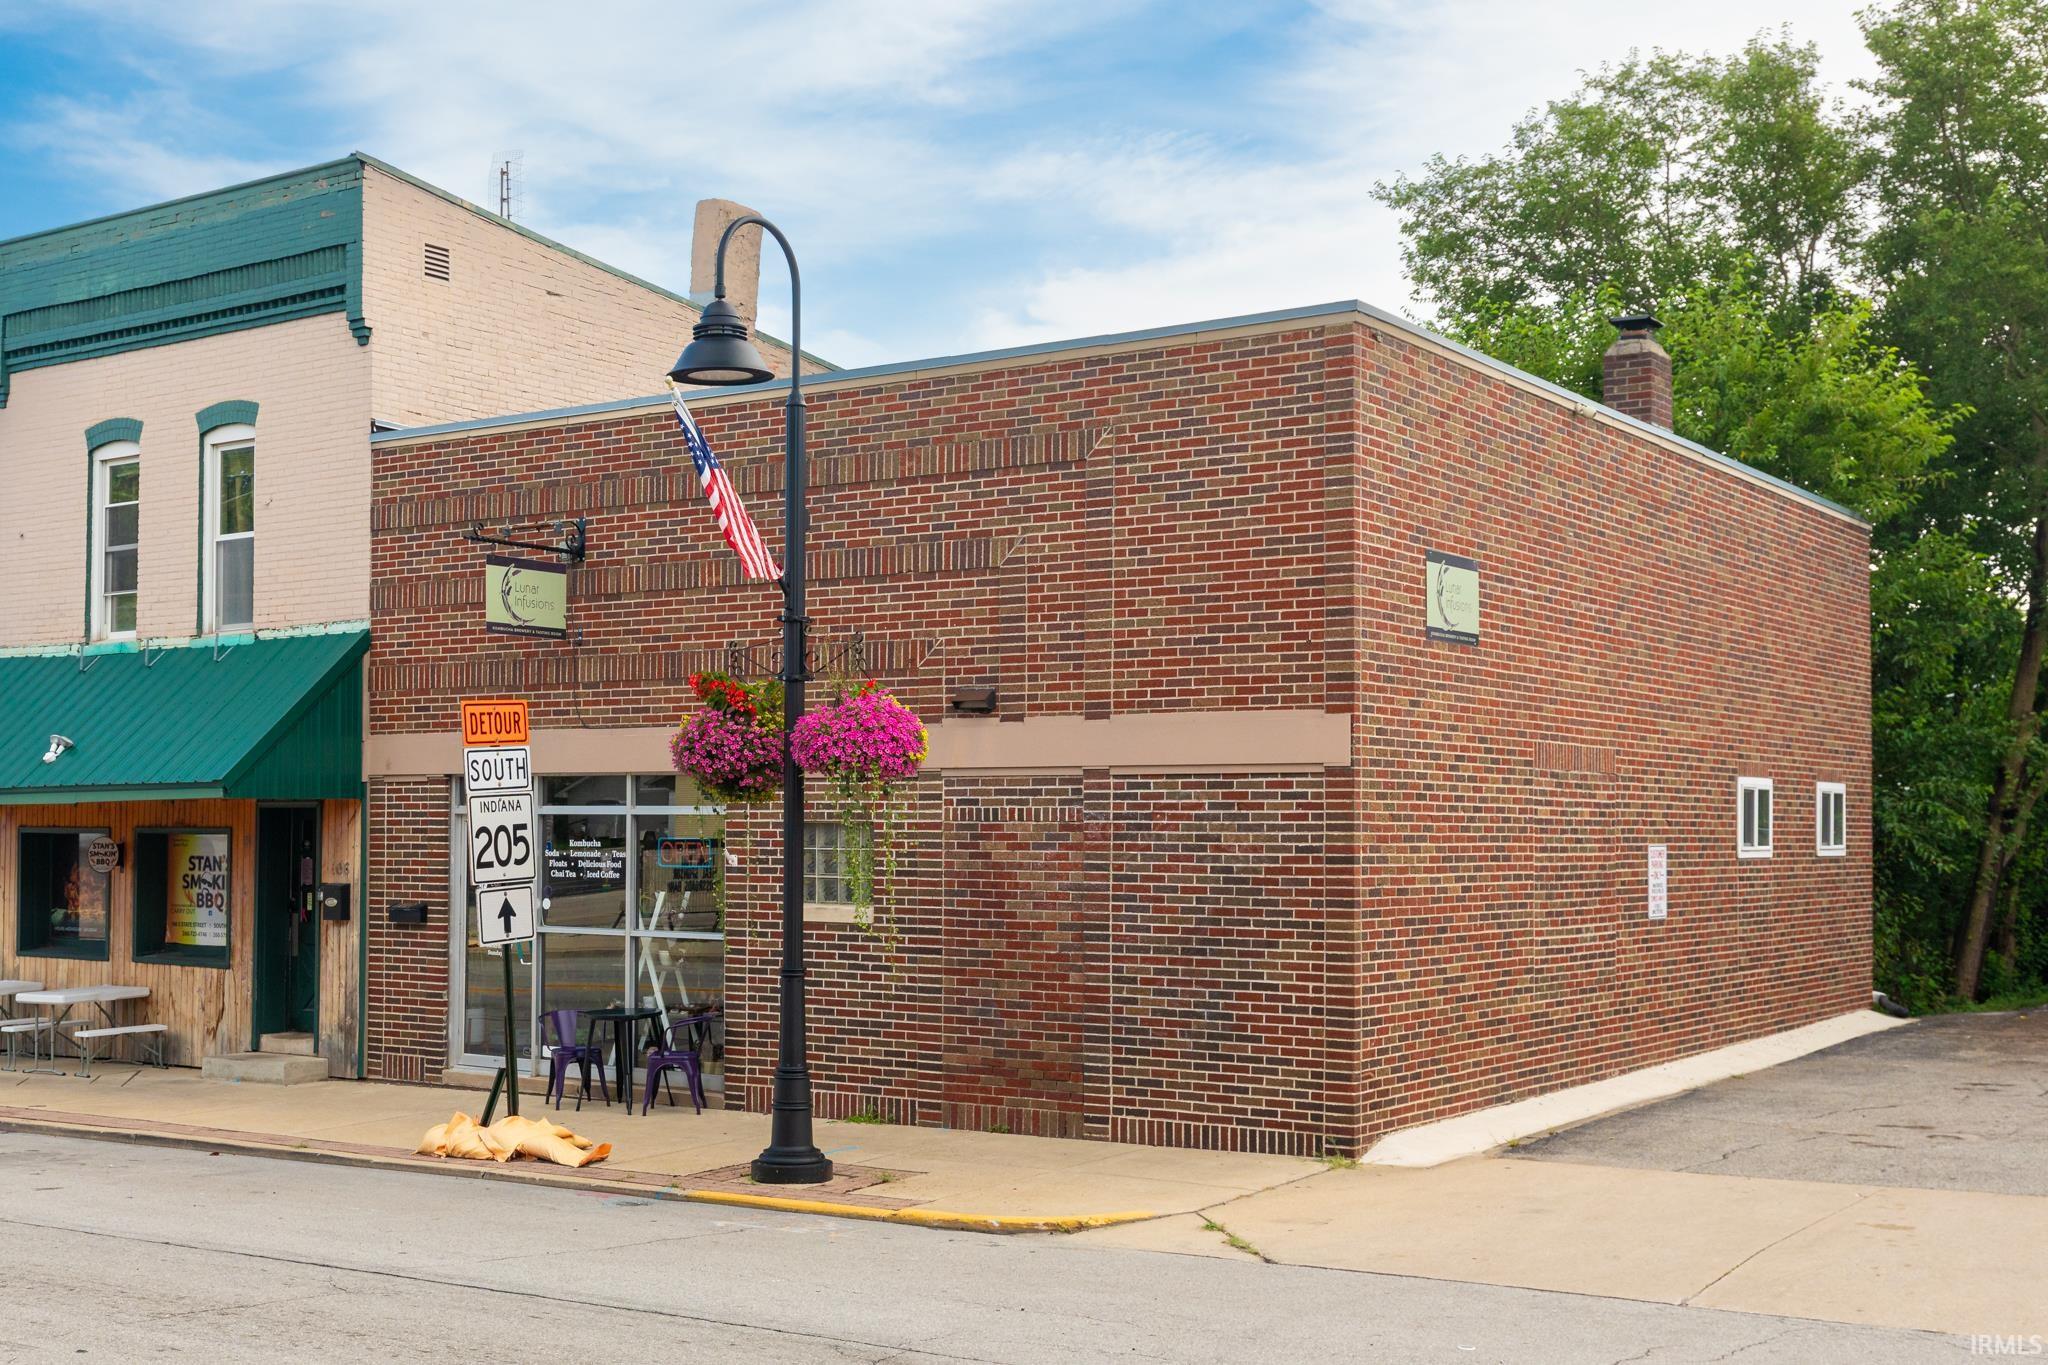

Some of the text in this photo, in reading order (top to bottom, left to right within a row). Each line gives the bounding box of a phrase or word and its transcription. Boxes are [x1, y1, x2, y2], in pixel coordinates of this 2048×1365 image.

[515, 582, 539, 594] Lunar
[515, 595, 555, 611] Infusions
[469, 711, 522, 735] DETOUR
[470, 757, 526, 782] SOUTH
[480, 799, 522, 813] INDIANA
[93, 842, 115, 850] STAN'S
[474, 823, 530, 869] 205
[569, 839, 602, 848] Kombucha
[544, 849, 559, 857] Soda
[570, 849, 601, 857] Lemonade
[661, 841, 709, 862] OPEN
[96, 858, 110, 866] BBQ
[188, 854, 229, 872] STAN'
[549, 859, 622, 868] Floats Delicious Food
[550, 870, 620, 878] Chai Tea Iced Coffee
[196, 892, 224, 912] BBQ
